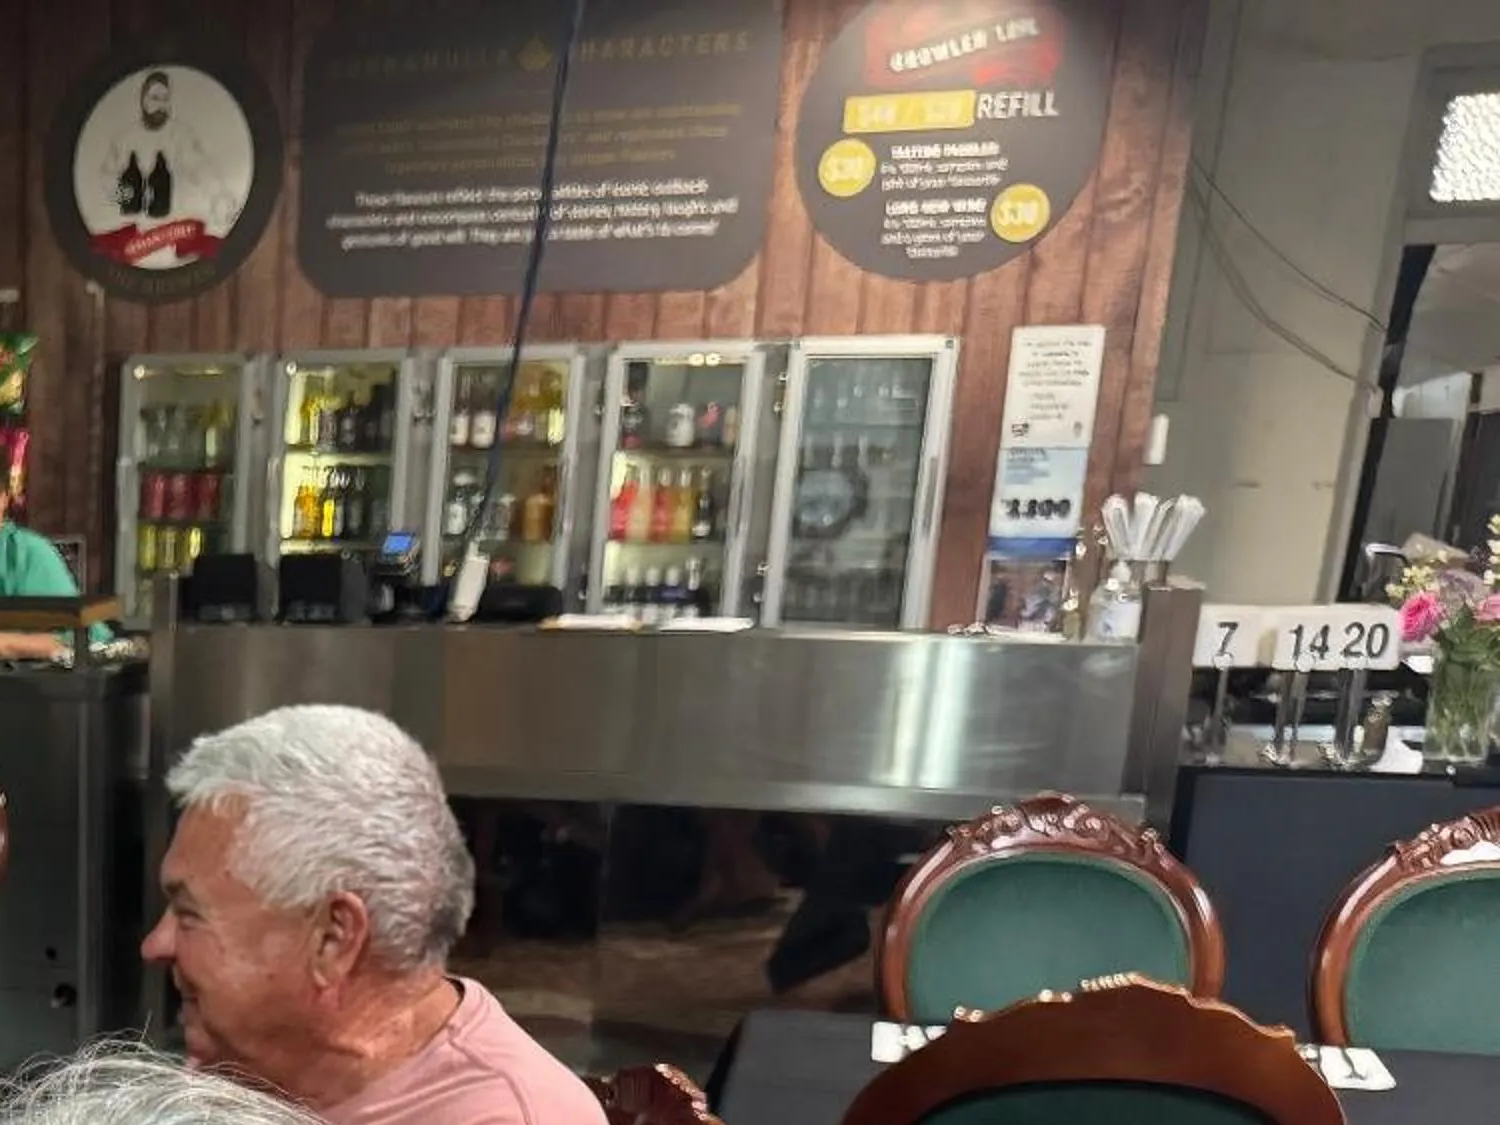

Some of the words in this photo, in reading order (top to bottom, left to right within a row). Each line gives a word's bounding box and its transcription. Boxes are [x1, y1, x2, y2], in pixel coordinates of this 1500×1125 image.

[566, 31, 750, 63] HARACTERS
[977, 91, 1059, 119] REFILL
[1217, 621, 1240, 658] 7
[1289, 624, 1331, 662] 14
[1340, 620, 1390, 659] 20
